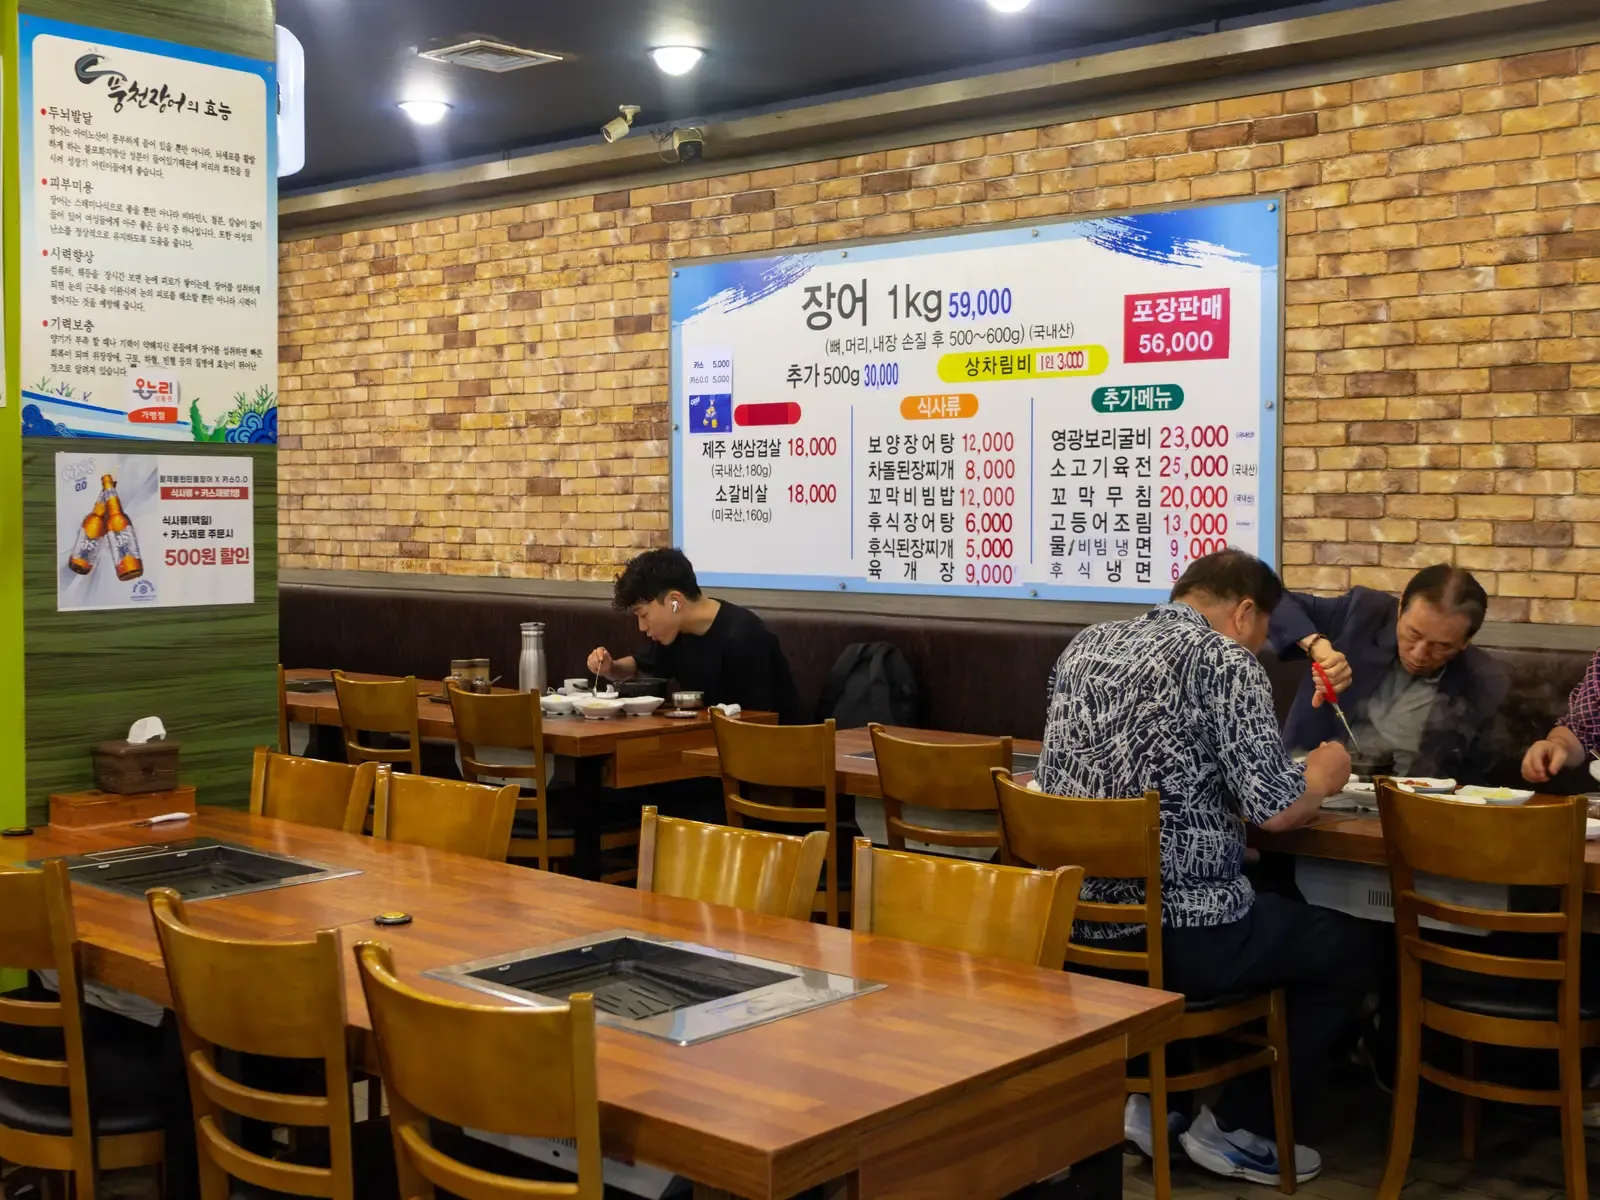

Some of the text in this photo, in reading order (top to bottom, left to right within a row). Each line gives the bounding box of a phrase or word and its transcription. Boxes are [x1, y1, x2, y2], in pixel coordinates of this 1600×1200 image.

[48, 106, 92, 125] 두뇌발달
[204, 99, 232, 121] 효능
[49, 124, 70, 137] 장어는
[50, 176, 94, 194] 피부미용
[50, 195, 72, 207] 장어는
[50, 246, 94, 264] 시력향상
[802, 278, 1012, 330] 장어 1kg 59,000
[1132, 294, 1222, 324] 포장판매
[50, 316, 95, 333] 기력보충
[824, 320, 1074, 356] (뼈,머리,내장 손질 후 500~600g) (국내산)
[1138, 330, 1214, 356] 56,000
[694, 360, 704, 368] 카스
[965, 353, 1032, 377] 상차림비
[786, 362, 899, 390] 추가 500g 30,000
[917, 396, 961, 417] 식사류
[1102, 386, 1172, 411] 추가메뉴
[141, 411, 165, 420] 가맹점
[702, 436, 837, 459] 제주 생삼겹살 18,000
[868, 432, 1014, 455] 보양장어탕 12,000
[1051, 424, 1228, 451] 영광보리굴비 23,000
[712, 464, 772, 478] (국내산,180g)
[868, 459, 1015, 483] 차돌된장찌개 8,000
[1050, 455, 1258, 480] 소고기육전 25,000 (국내산)
[715, 484, 837, 506] 소갈비살 18,000
[868, 486, 1015, 508] 꼬막비빔밥 12,000
[1050, 485, 1150, 508] 꼬막무침
[1160, 485, 1228, 510] 20,000
[162, 515, 212, 526] 식사류(택일)
[712, 508, 772, 523] (미국산,160g)
[868, 512, 1013, 536] 후식장어탕 6,000
[1050, 512, 1228, 538] 고등어조림 13,000
[171, 529, 206, 540] 카스제로
[208, 528, 234, 538] 주문시
[164, 547, 250, 566] 500원 할인
[868, 538, 1014, 560] 후식된장찌개 5,000
[1170, 538, 1228, 562] 9,000
[966, 564, 1012, 586] 9,000
